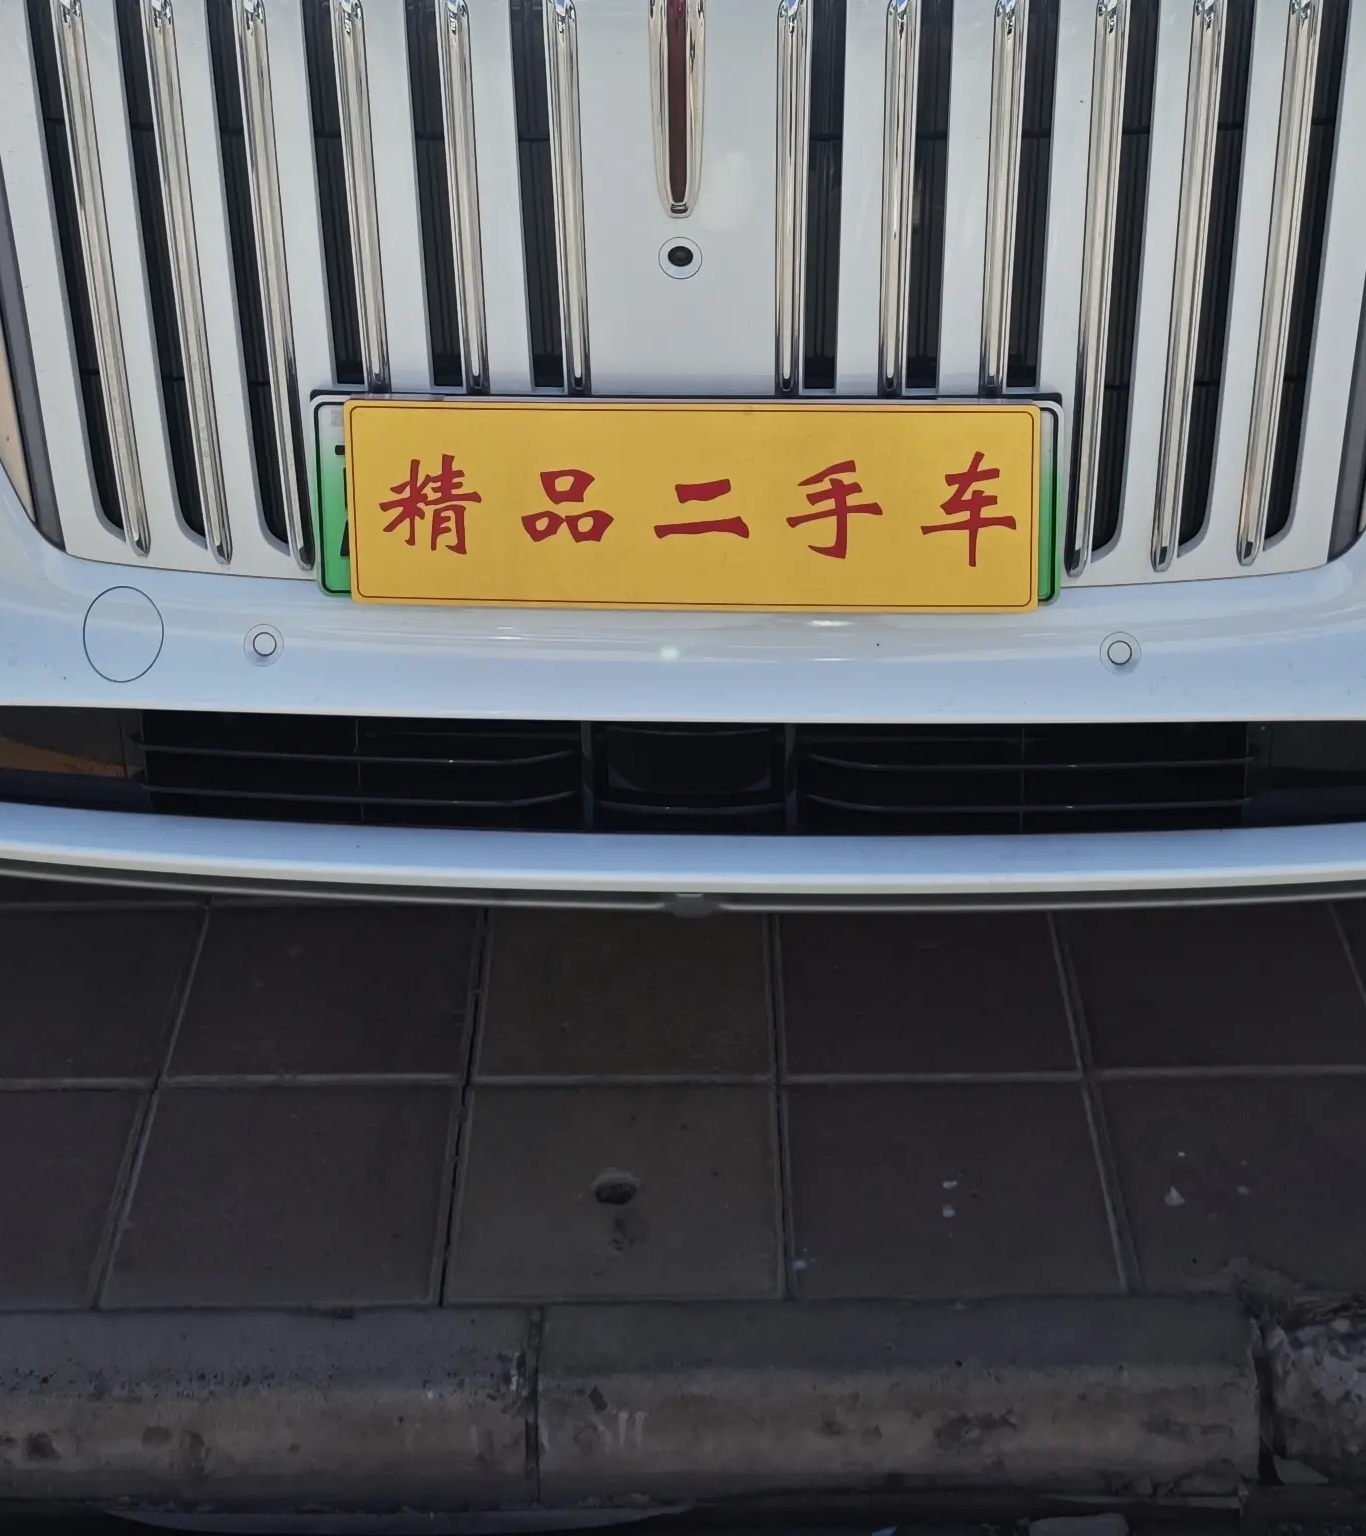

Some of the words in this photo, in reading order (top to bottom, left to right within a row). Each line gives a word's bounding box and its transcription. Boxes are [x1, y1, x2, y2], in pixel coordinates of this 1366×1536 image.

[379, 451, 1017, 568] 精品二手车
